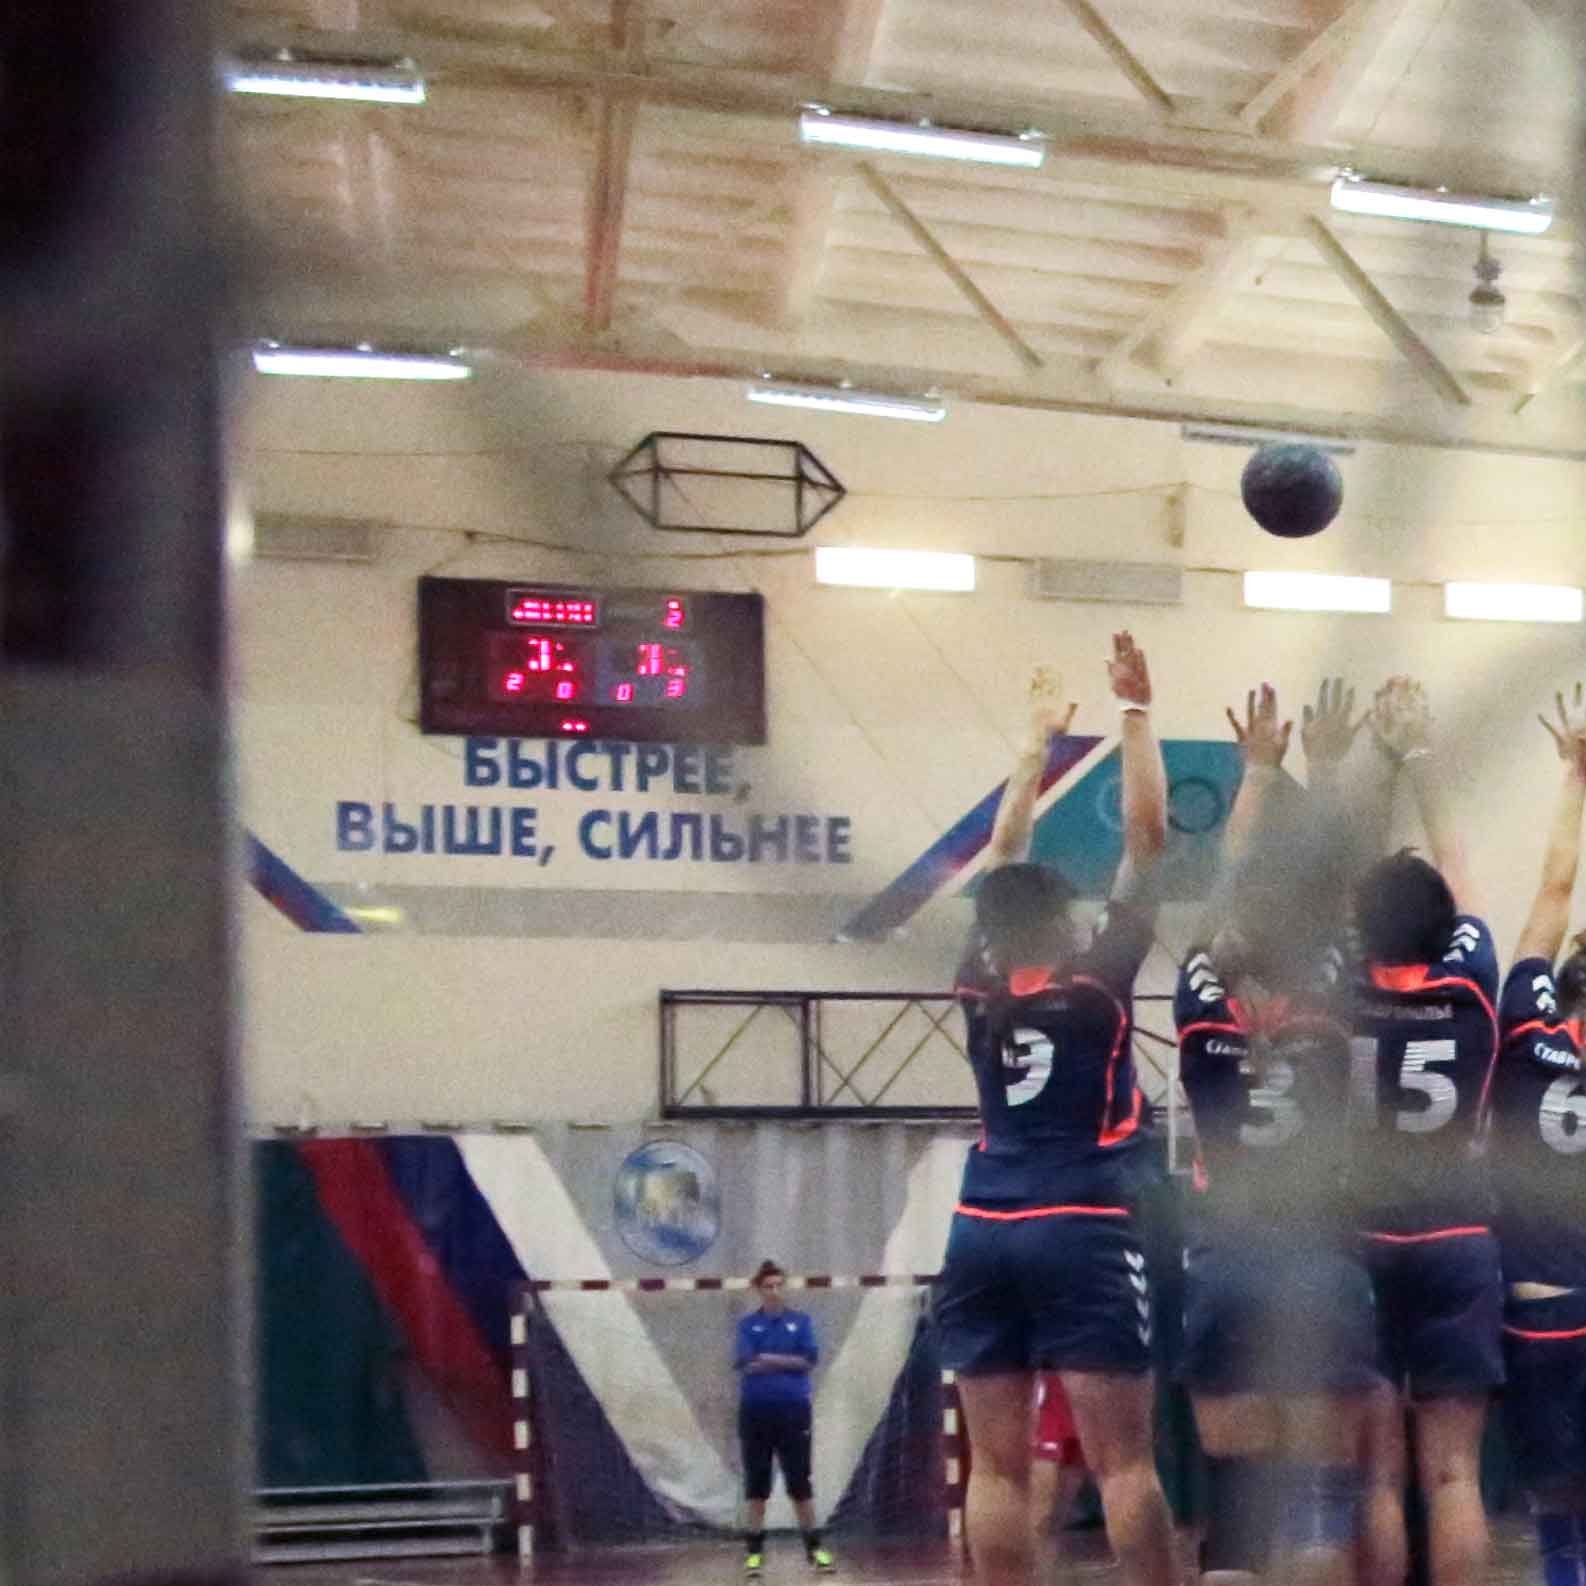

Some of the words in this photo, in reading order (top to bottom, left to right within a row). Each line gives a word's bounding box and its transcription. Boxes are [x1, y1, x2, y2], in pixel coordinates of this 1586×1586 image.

[464, 737, 750, 800] БЫСТРЕЕ,
[336, 801, 555, 866] ВЫШЕ,
[577, 808, 851, 863] СИЛЬНЕЕ
[1001, 1028, 1055, 1106] 9
